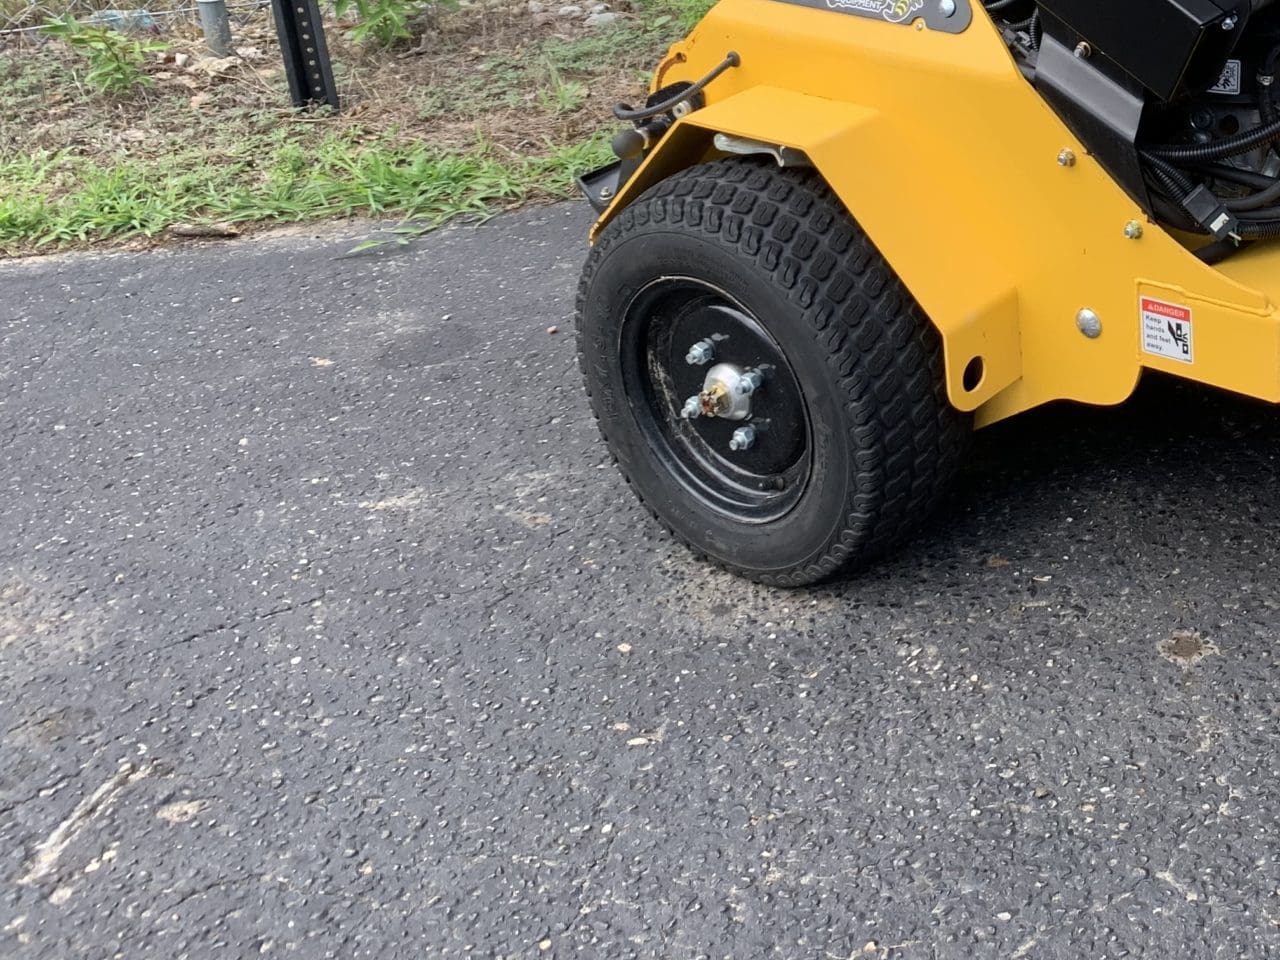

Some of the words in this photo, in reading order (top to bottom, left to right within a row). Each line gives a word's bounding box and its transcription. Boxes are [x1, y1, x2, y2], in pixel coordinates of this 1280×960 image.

[1153, 304, 1185, 318] DANGER
[1145, 315, 1161, 324] Keep
[1145, 323, 1165, 333] hands
